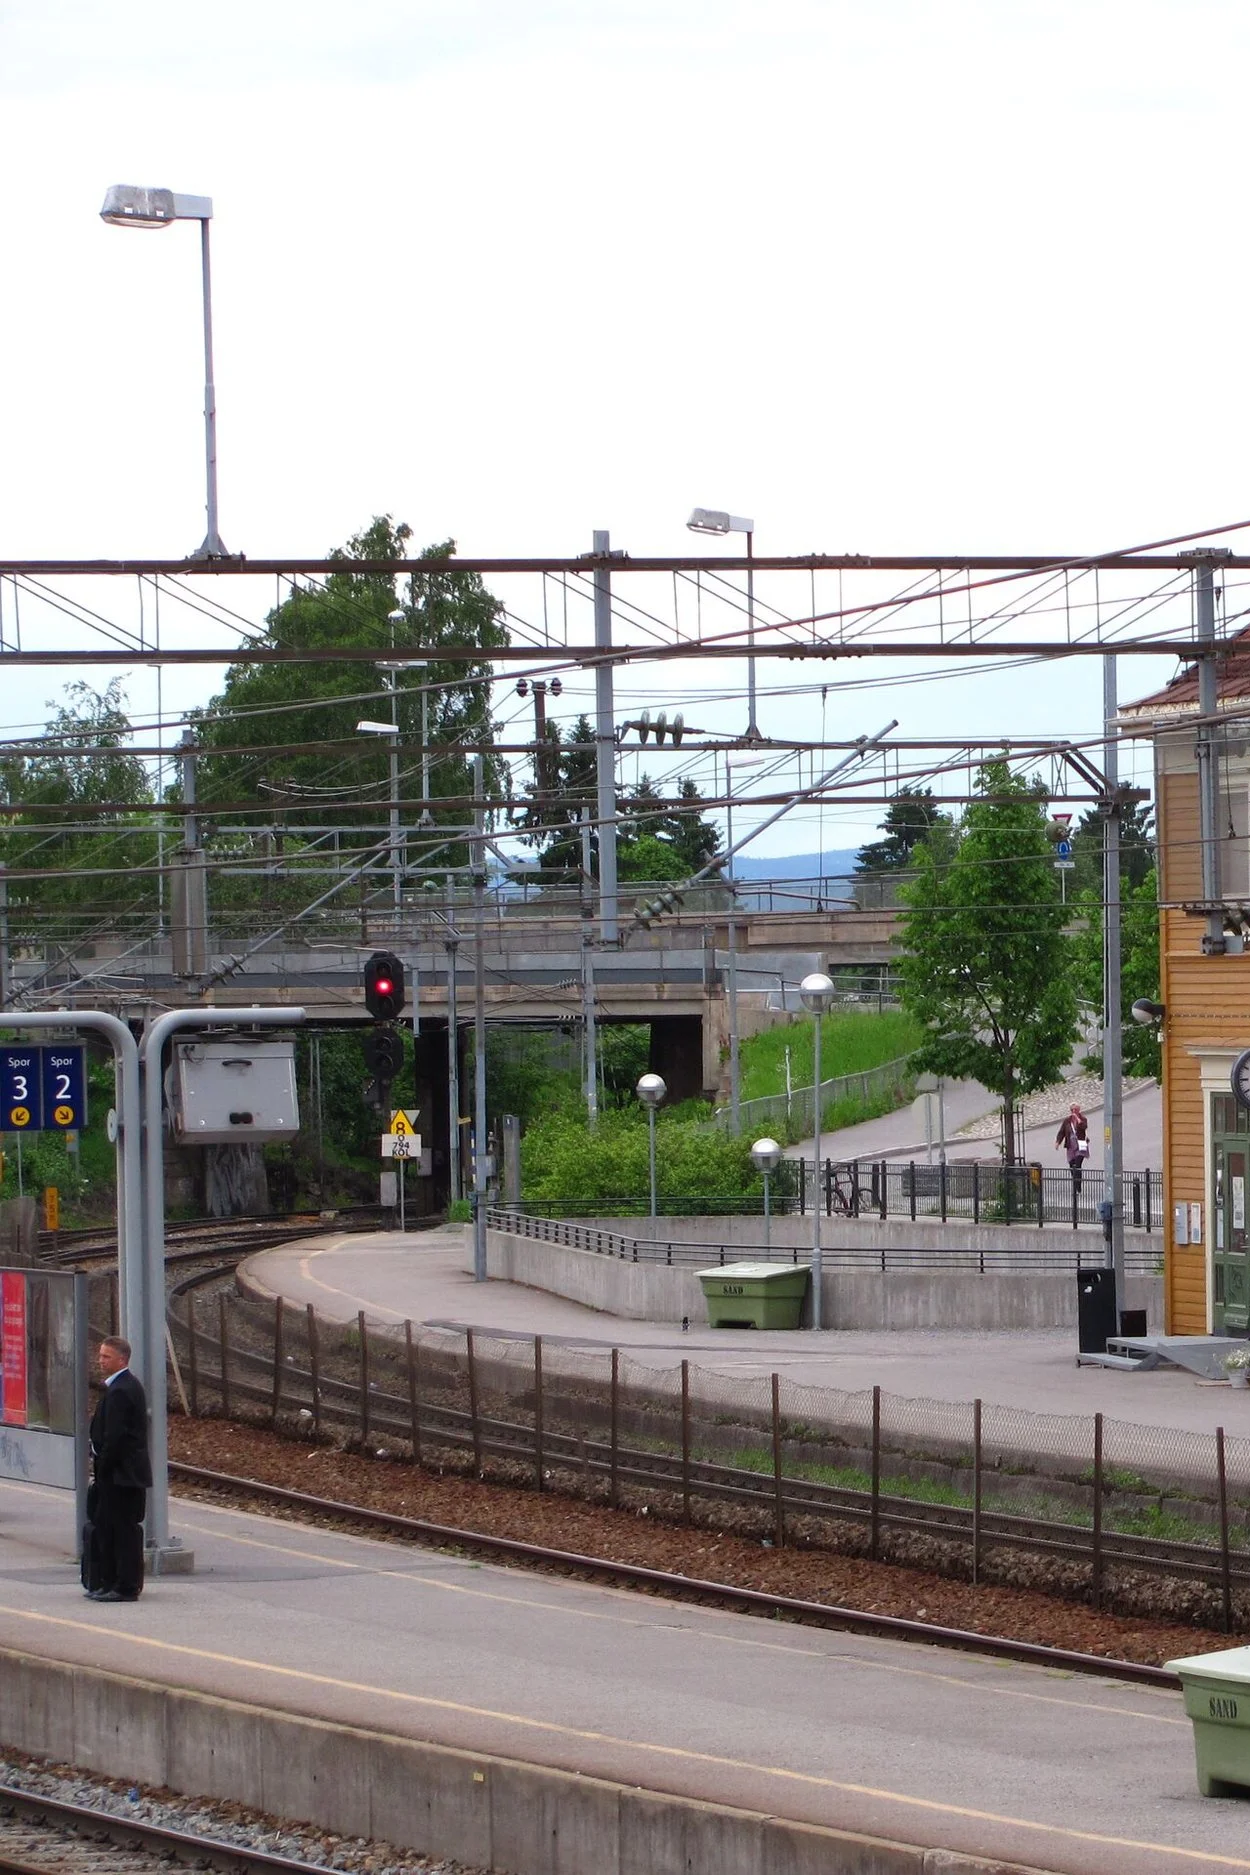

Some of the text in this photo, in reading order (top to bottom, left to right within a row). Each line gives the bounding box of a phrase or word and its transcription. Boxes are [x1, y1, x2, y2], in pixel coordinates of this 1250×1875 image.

[8, 1057, 31, 1069] Spor
[50, 1056, 74, 1068] Spor
[13, 1075, 28, 1100] 3
[56, 1074, 72, 1099] 2
[396, 1121, 406, 1135] 8
[723, 1285, 744, 1295] SAND
[1209, 1697, 1238, 1719] SAND
